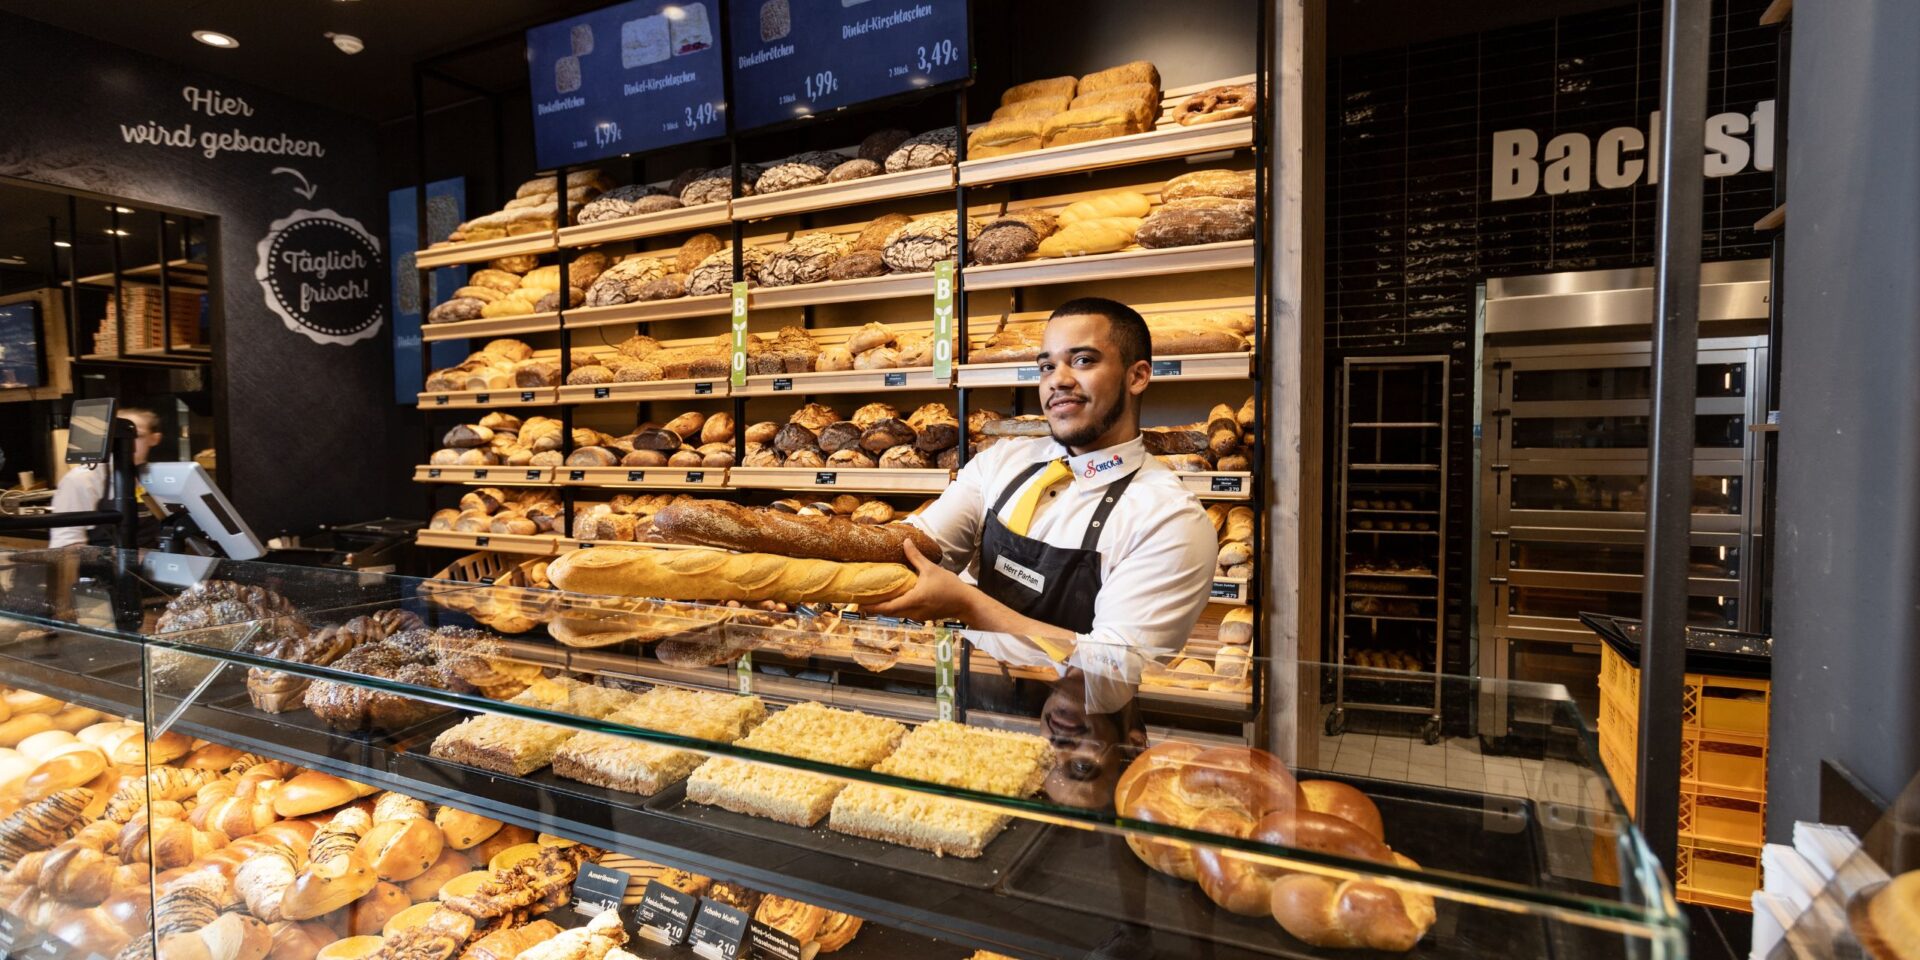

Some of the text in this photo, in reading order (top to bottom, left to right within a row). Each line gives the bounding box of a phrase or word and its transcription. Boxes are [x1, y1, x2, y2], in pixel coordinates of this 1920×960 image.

[842, 4, 932, 40] Dinkel-Kirschtaschen
[182, 86, 254, 116] Hier
[120, 121, 326, 159] wird gebacken
[1491, 100, 1775, 202] Bacst
[282, 250, 368, 280] Täglich
[300, 279, 369, 313] frisch!
[733, 297, 746, 371] BIO
[936, 278, 951, 361] BIO
[1003, 563, 1039, 586] Herr Parham
[671, 908, 688, 921] Muffin
[704, 905, 740, 926] Schoko Muffin
[789, 943, 800, 954] mit
